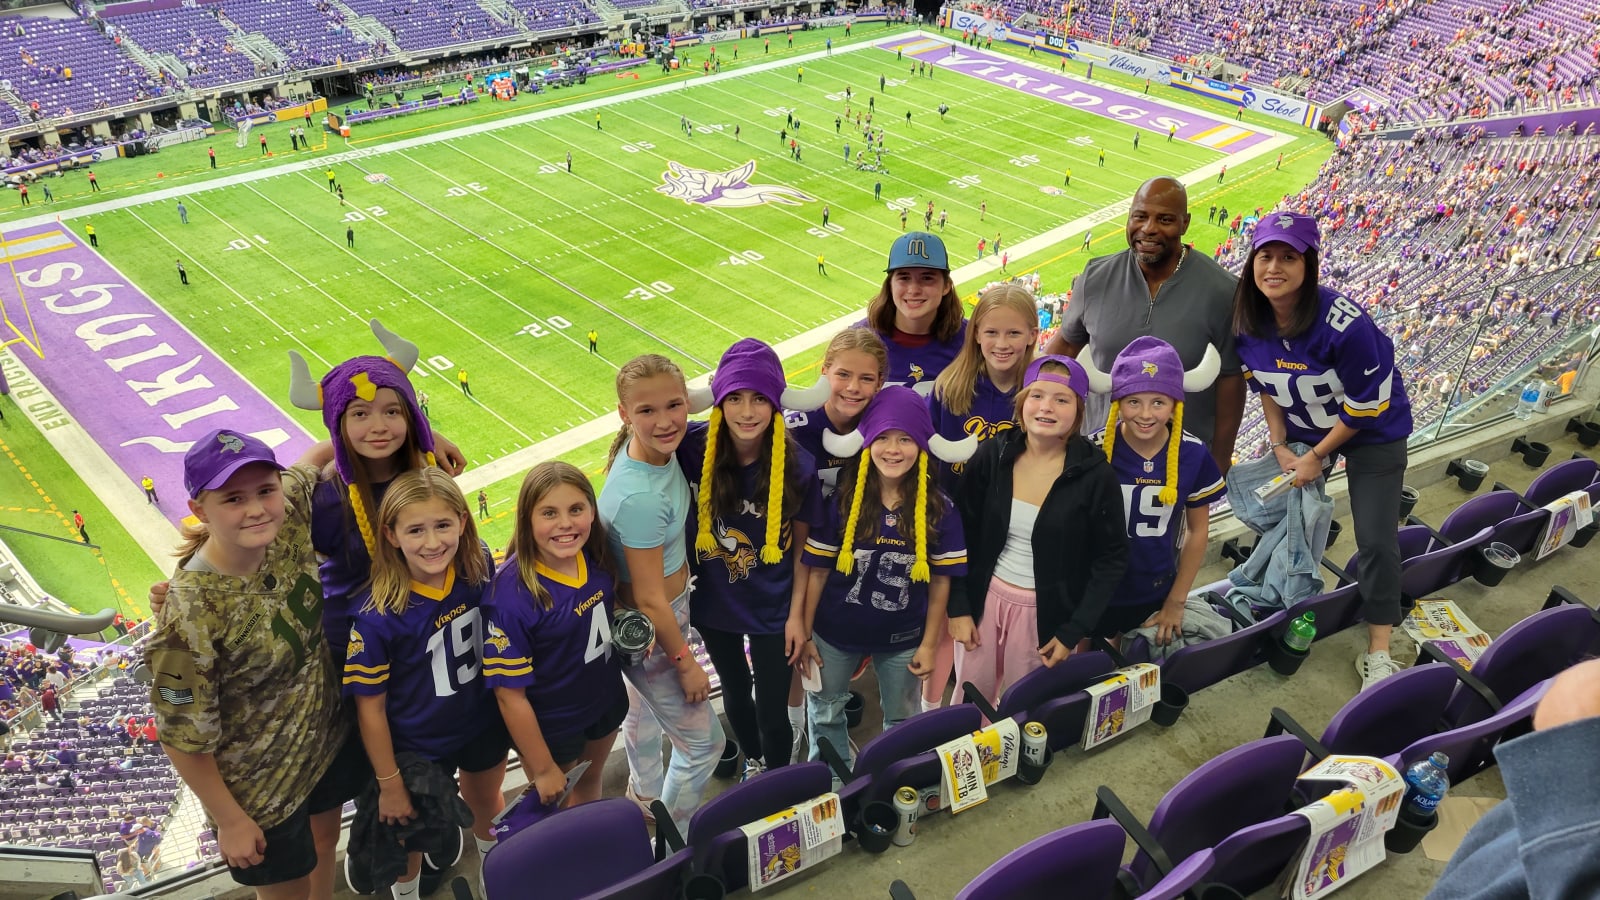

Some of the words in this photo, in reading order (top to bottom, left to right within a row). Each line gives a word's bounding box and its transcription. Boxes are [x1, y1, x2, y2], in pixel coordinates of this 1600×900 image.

[957, 16, 987, 32] Skl
[1109, 54, 1147, 77] Vikings
[1262, 98, 1300, 117] Skol
[1325, 296, 1362, 333] 28
[28, 400, 71, 431] END
[1120, 484, 1175, 539] 19
[845, 549, 916, 611] 19
[233, 611, 262, 647] MINNESOTA
[584, 601, 613, 665] 4
[425, 606, 484, 697] 19
[957, 784, 969, 799] TB
[966, 770, 979, 793] MIN
